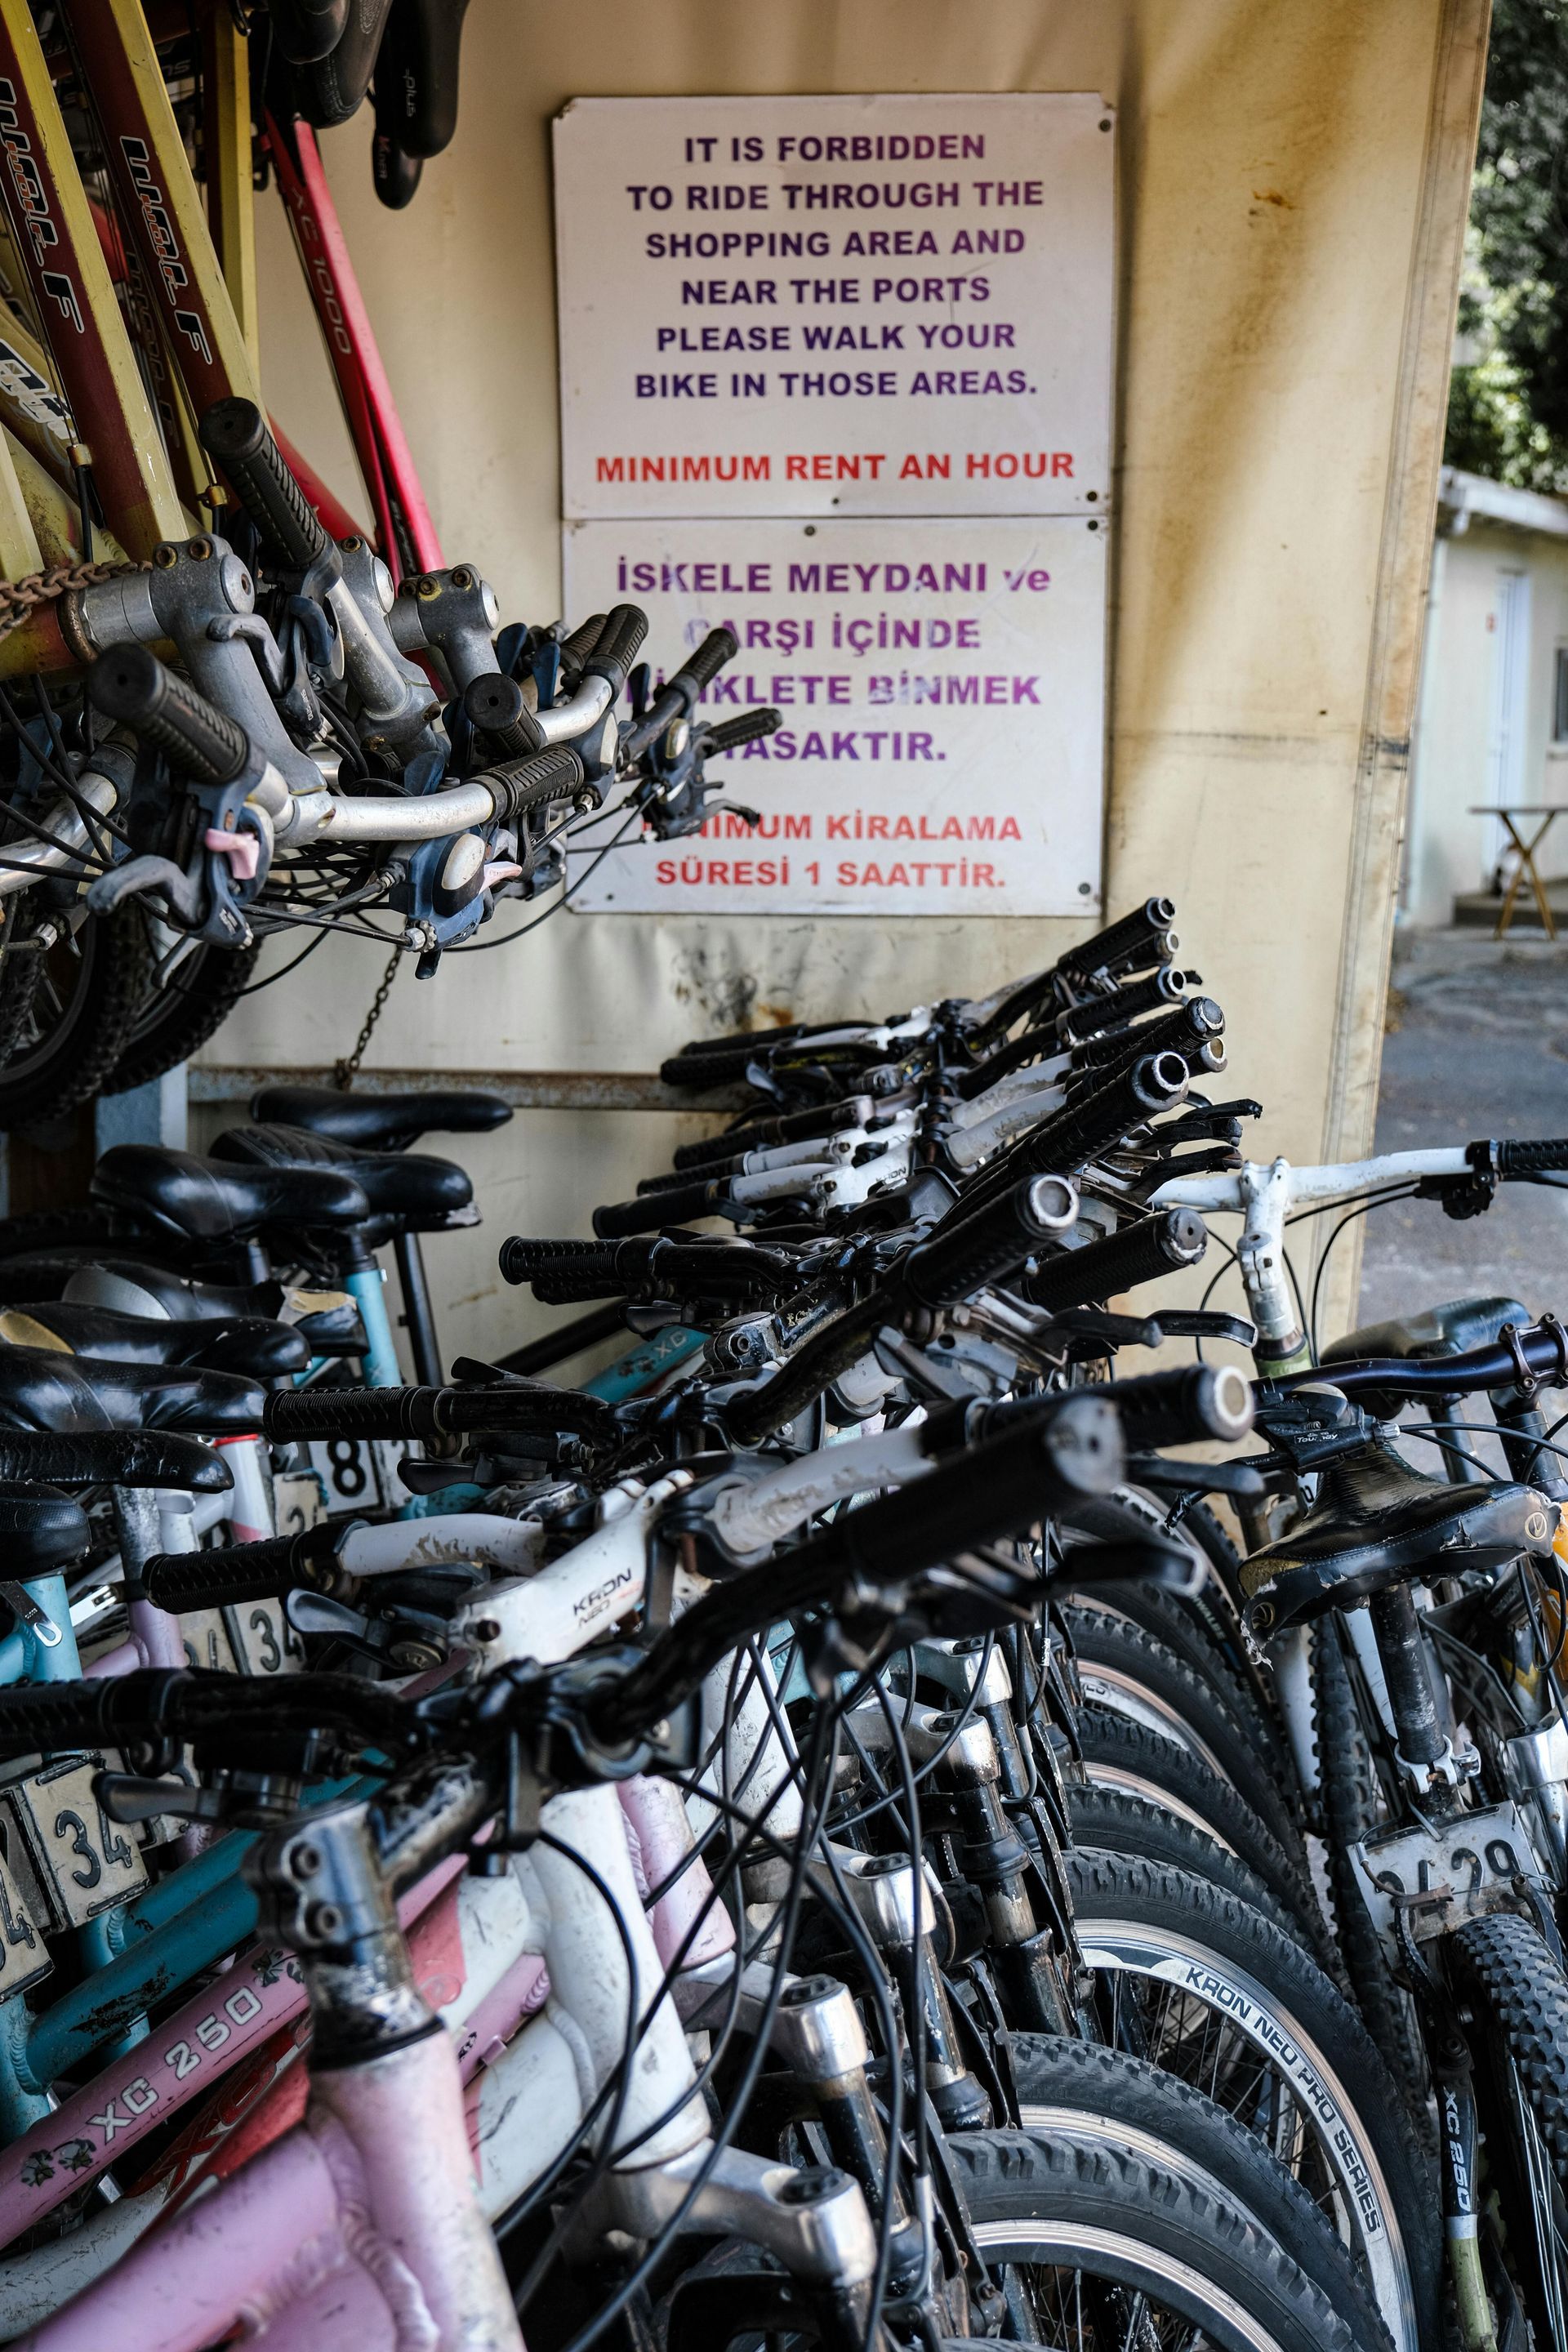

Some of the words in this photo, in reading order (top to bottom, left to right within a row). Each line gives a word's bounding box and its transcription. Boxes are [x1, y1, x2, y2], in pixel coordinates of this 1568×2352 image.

[684, 136, 719, 163] IT
[731, 136, 765, 163] IS
[777, 134, 986, 163] FORBIDDEN
[626, 185, 674, 212] TO
[686, 185, 769, 211] RIDE
[780, 182, 960, 210] THROUGH
[972, 180, 1044, 207] THE
[645, 231, 831, 259] SHOPPING
[842, 229, 939, 257] AREA
[951, 229, 1025, 255] AND
[313, 255, 352, 355] 1000
[681, 279, 777, 305] NEAR
[788, 278, 860, 305] THE
[873, 277, 990, 303] PORTS
[657, 326, 791, 352] PLEASE
[802, 325, 904, 350] WALK
[917, 323, 1015, 349] YOUR
[635, 373, 718, 399] BIKE
[731, 373, 766, 398] IN
[778, 372, 898, 397] THOSE
[910, 370, 1037, 395] AREAS.
[596, 456, 771, 483] MINIMUM
[786, 454, 886, 480] RENT
[899, 454, 951, 479] AN
[965, 453, 1074, 479] HOUR
[617, 555, 772, 593] İSKELE
[788, 563, 987, 593] MEYDANI
[1004, 569, 1050, 592] ve
[832, 612, 980, 656] İÇİNDE
[868, 670, 1040, 705] BİNMEK
[827, 808, 1022, 840] KİRALAMA
[656, 856, 789, 886] SÜRESİ
[804, 862, 819, 885] 1
[837, 858, 1005, 887] SAATTİR.
[572, 1567, 633, 1616] KRON
[55, 1810, 133, 1889] 34
[85, 2076, 160, 2145] XC
[163, 1985, 263, 2081] 250
[1184, 1966, 1253, 2020] KRON
[1253, 2017, 1299, 2066] NEO
[1296, 2067, 1337, 2124] PRO
[1333, 2128, 1383, 2232] SERIES
[1442, 2084, 1461, 2136] XC
[1448, 2140, 1472, 2212] 250
